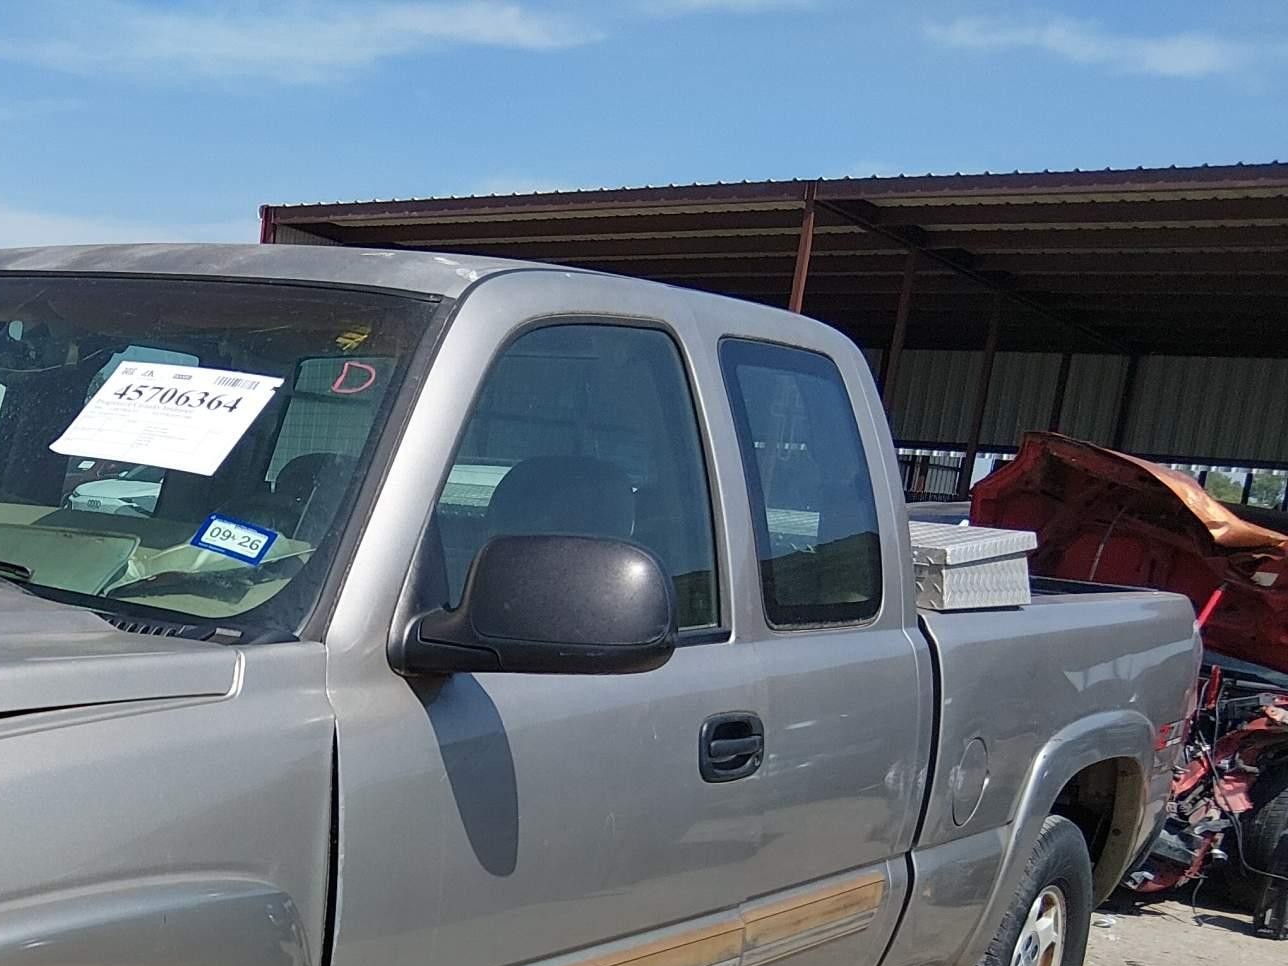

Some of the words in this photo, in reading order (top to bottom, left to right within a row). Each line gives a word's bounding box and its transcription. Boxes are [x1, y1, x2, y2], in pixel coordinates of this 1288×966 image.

[331, 361, 376, 393] D
[114, 383, 244, 413] 45706364
[237, 535, 263, 551] 26
